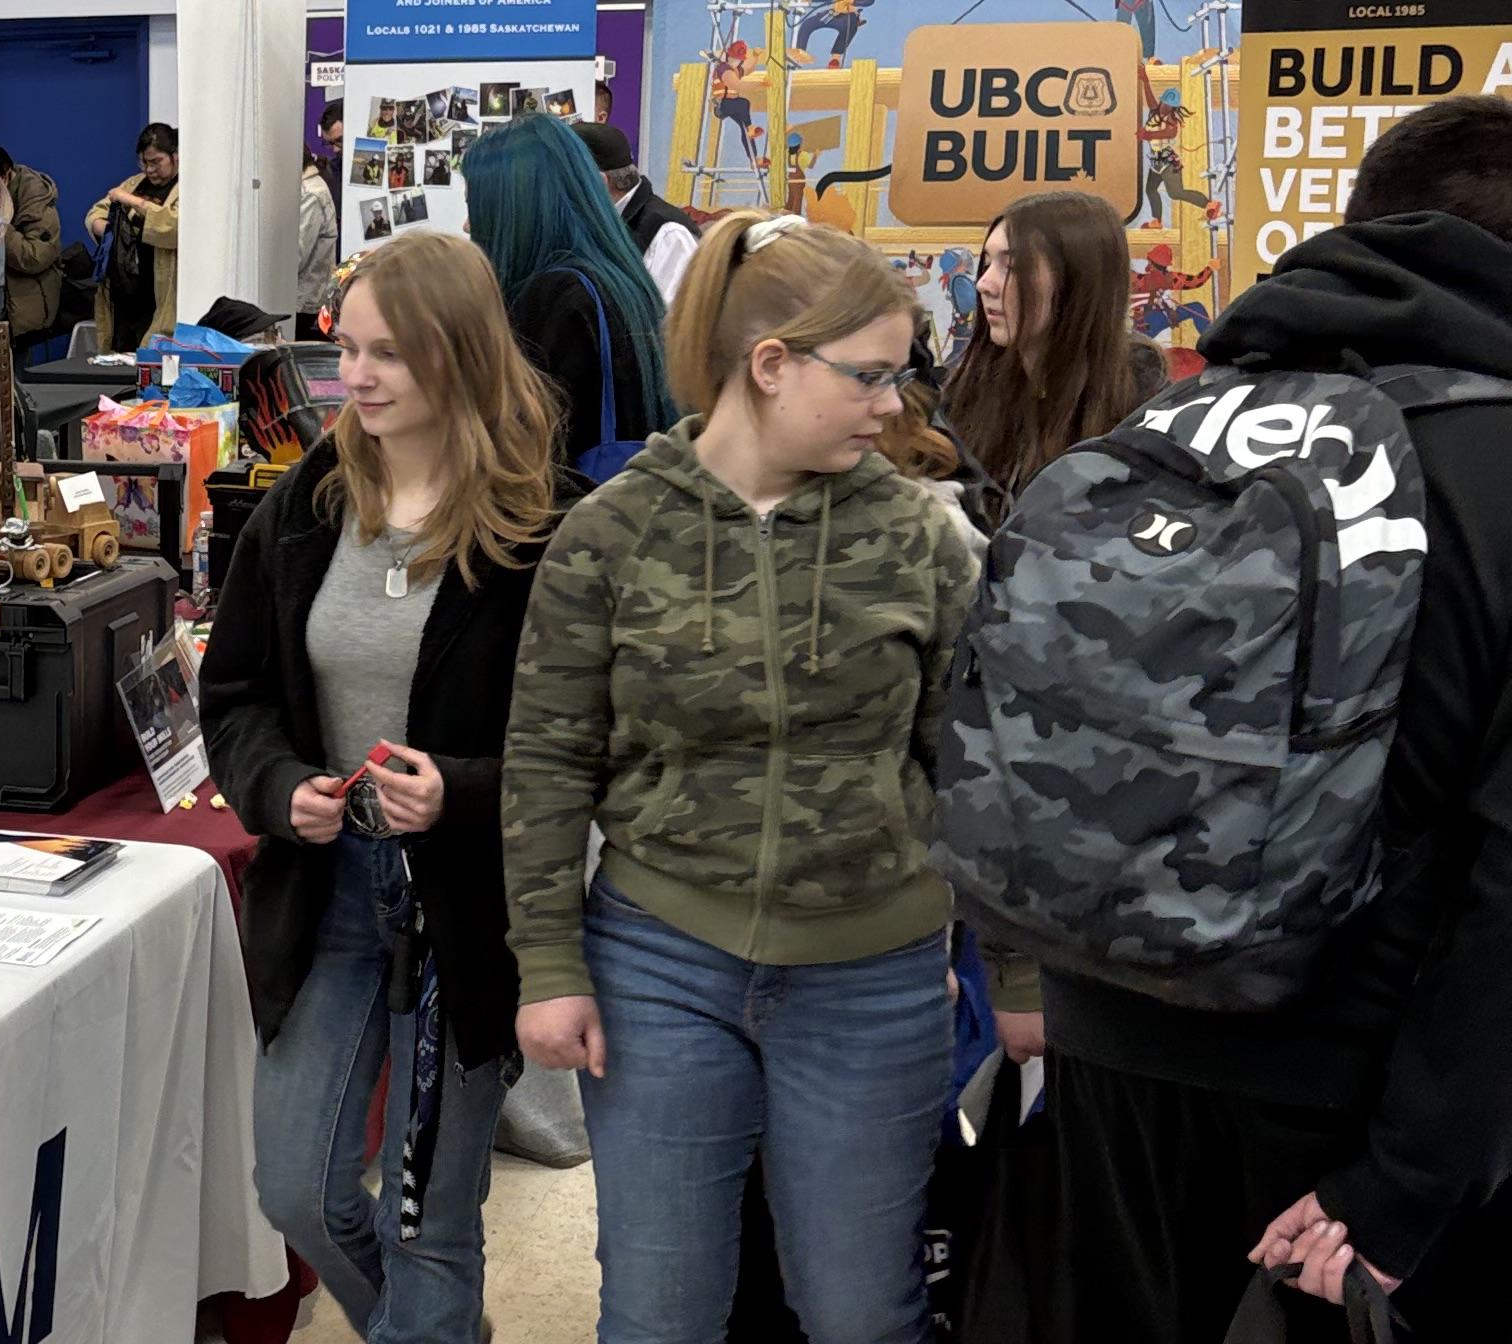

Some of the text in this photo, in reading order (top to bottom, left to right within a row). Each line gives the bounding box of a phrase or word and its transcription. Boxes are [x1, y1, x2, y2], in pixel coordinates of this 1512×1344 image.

[366, 23, 580, 36] LOCALS 1021 & 1985 SASKATCHEWAN
[1349, 4, 1425, 18] LOCAL 1985
[929, 67, 1069, 119] UBC
[1268, 44, 1463, 97] BUILD
[922, 129, 1112, 183] BUILT
